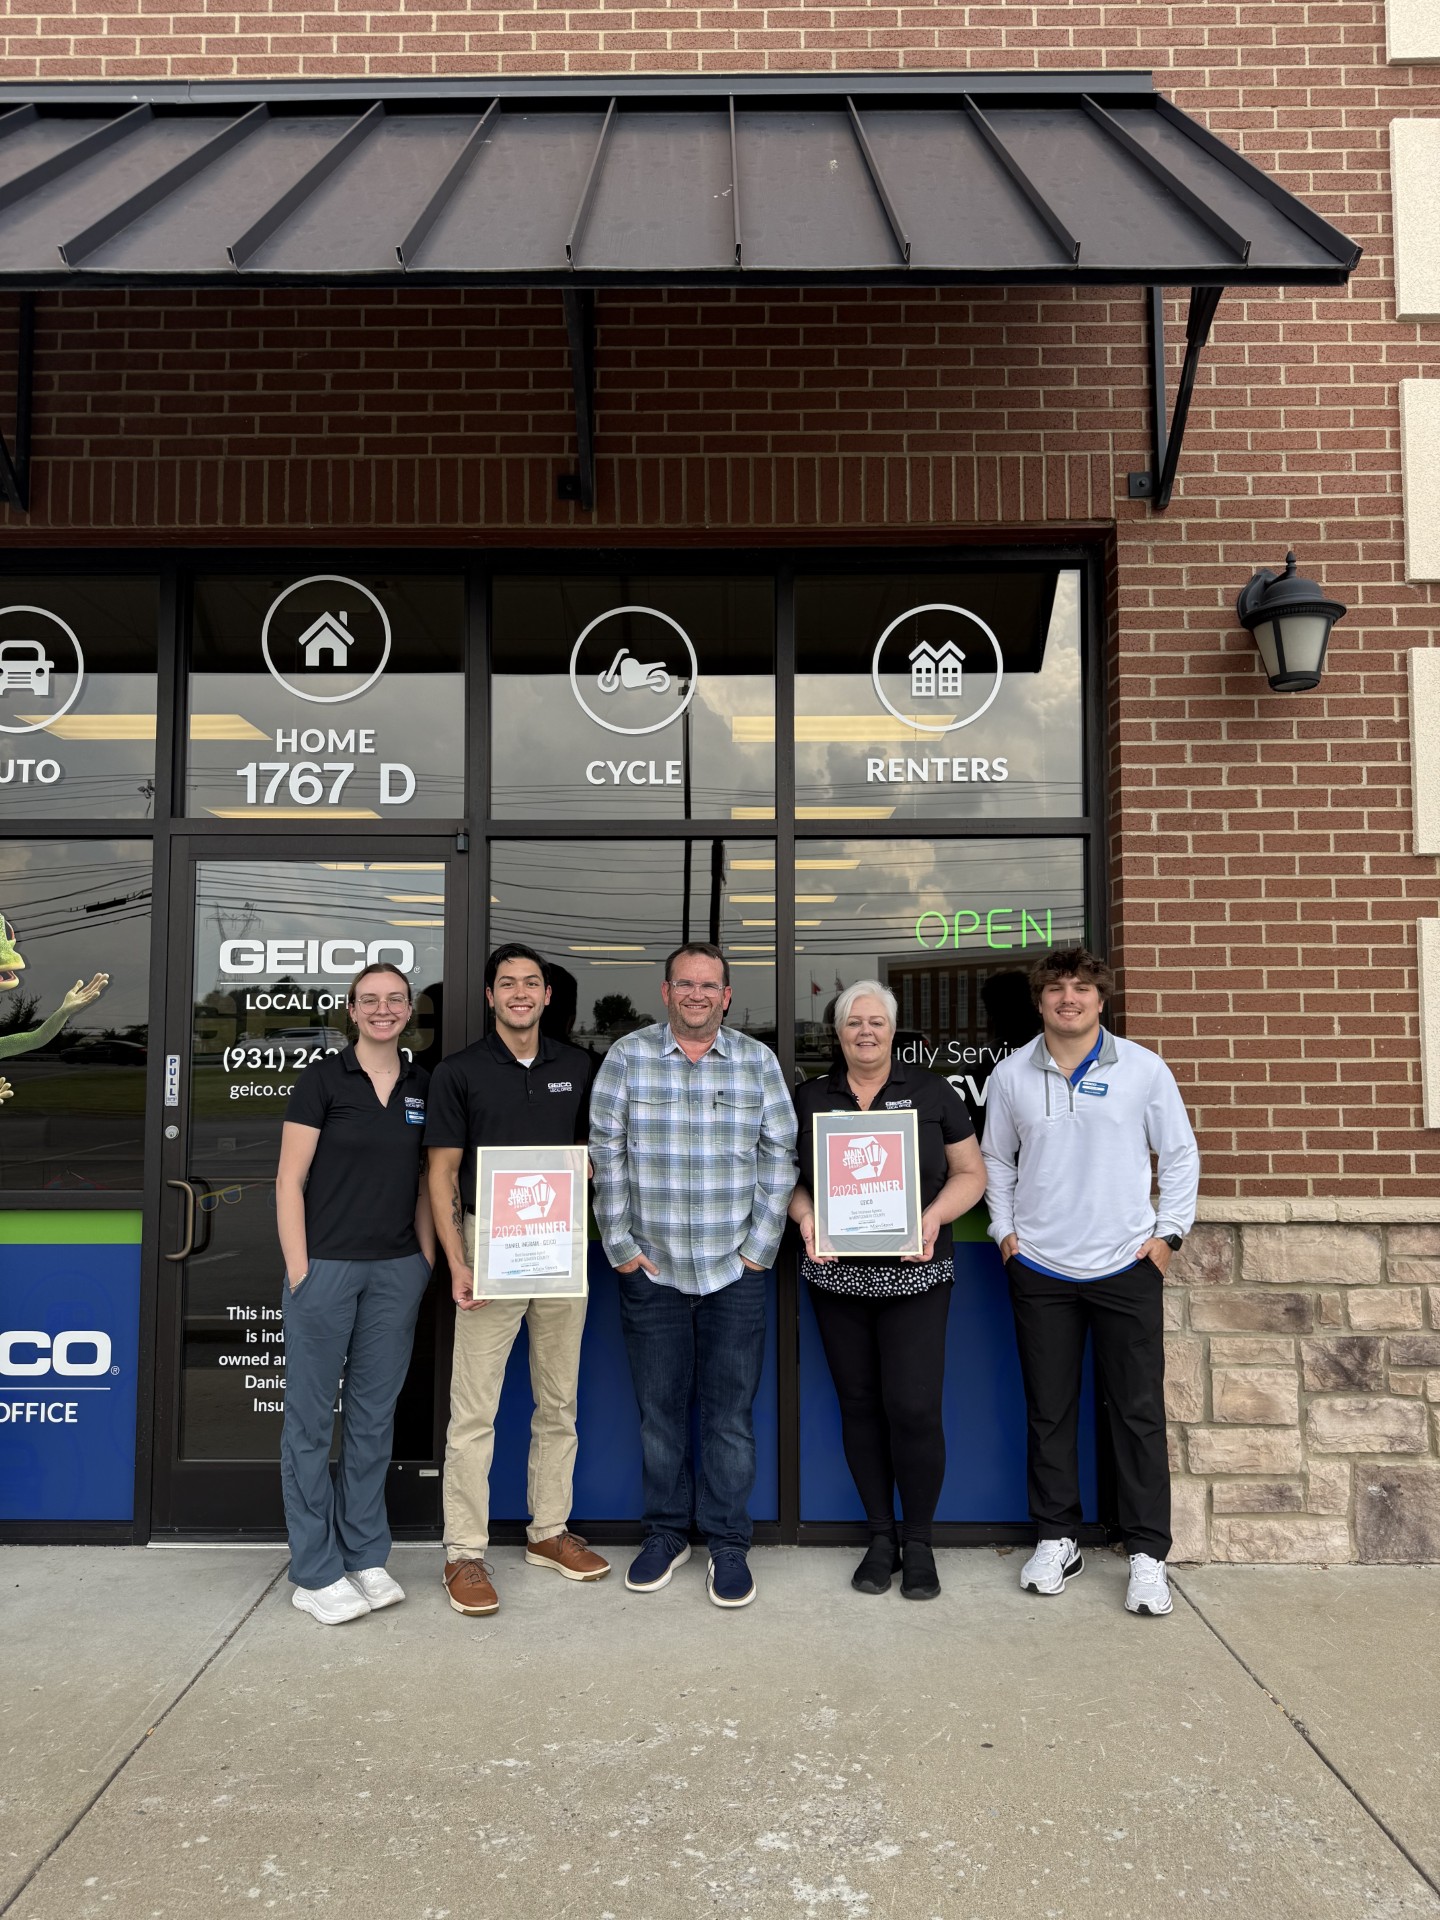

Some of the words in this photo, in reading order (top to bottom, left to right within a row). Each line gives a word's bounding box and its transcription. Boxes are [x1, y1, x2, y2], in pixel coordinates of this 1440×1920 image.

[276, 729, 376, 753] HOME
[0, 759, 61, 784] UTO
[585, 760, 682, 785] CYCLE
[866, 757, 1009, 783] RENTERS
[236, 762, 355, 804] 1767
[379, 763, 416, 804] D
[915, 908, 1053, 949] OPEN
[219, 939, 415, 974] GEICO
[245, 993, 312, 1010] LOCAL
[223, 1046, 286, 1073] (931)
[169, 1058, 177, 1096] PULL
[842, 1155, 865, 1167] STREET
[843, 1148, 862, 1158] MAIN
[510, 1187, 529, 1197] MAIN
[832, 1184, 858, 1197] 2026
[859, 1179, 901, 1195] WINNER
[507, 1194, 533, 1206] STREET
[494, 1225, 522, 1239] 2026
[525, 1220, 567, 1236] WINNER
[226, 1305, 258, 1320] This
[261, 1305, 283, 1320] ins
[246, 1328, 258, 1343] is
[261, 1328, 285, 1343] ind
[218, 1351, 269, 1366] owned
[245, 1374, 287, 1389] Danie
[253, 1397, 284, 1412] Insu
